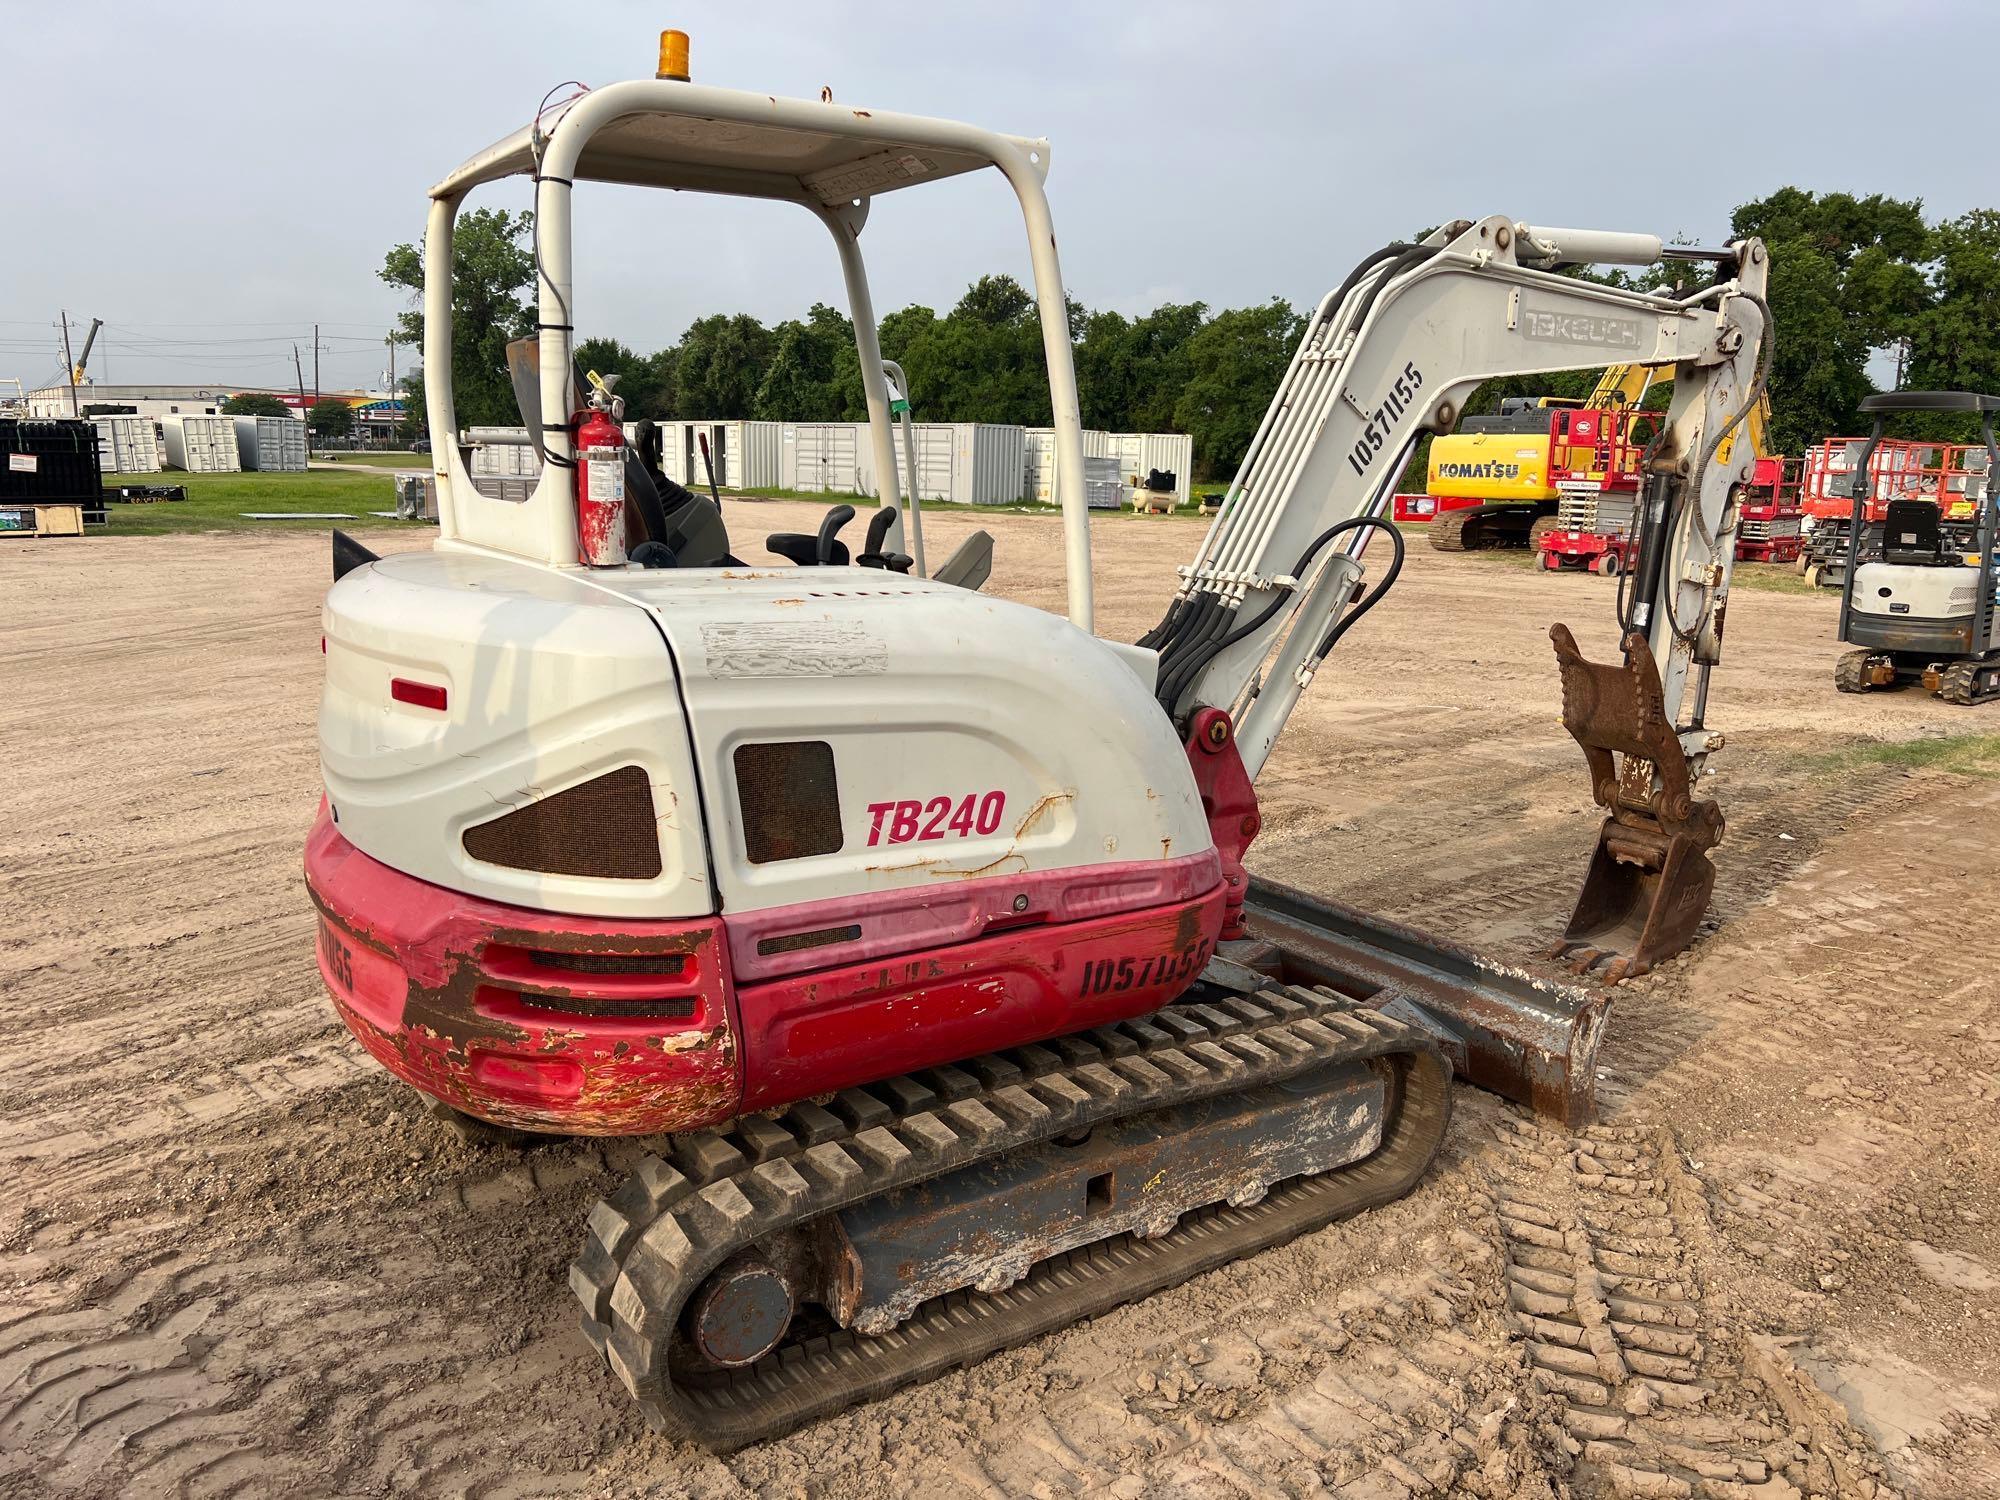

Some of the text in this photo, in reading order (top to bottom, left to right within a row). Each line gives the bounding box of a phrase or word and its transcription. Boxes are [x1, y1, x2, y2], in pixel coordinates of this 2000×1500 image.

[1347, 360, 1423, 477] 10571155
[1439, 460, 1519, 478] KOMATSU
[866, 790, 1006, 847] TB240
[1079, 937, 1210, 998] 10571155
